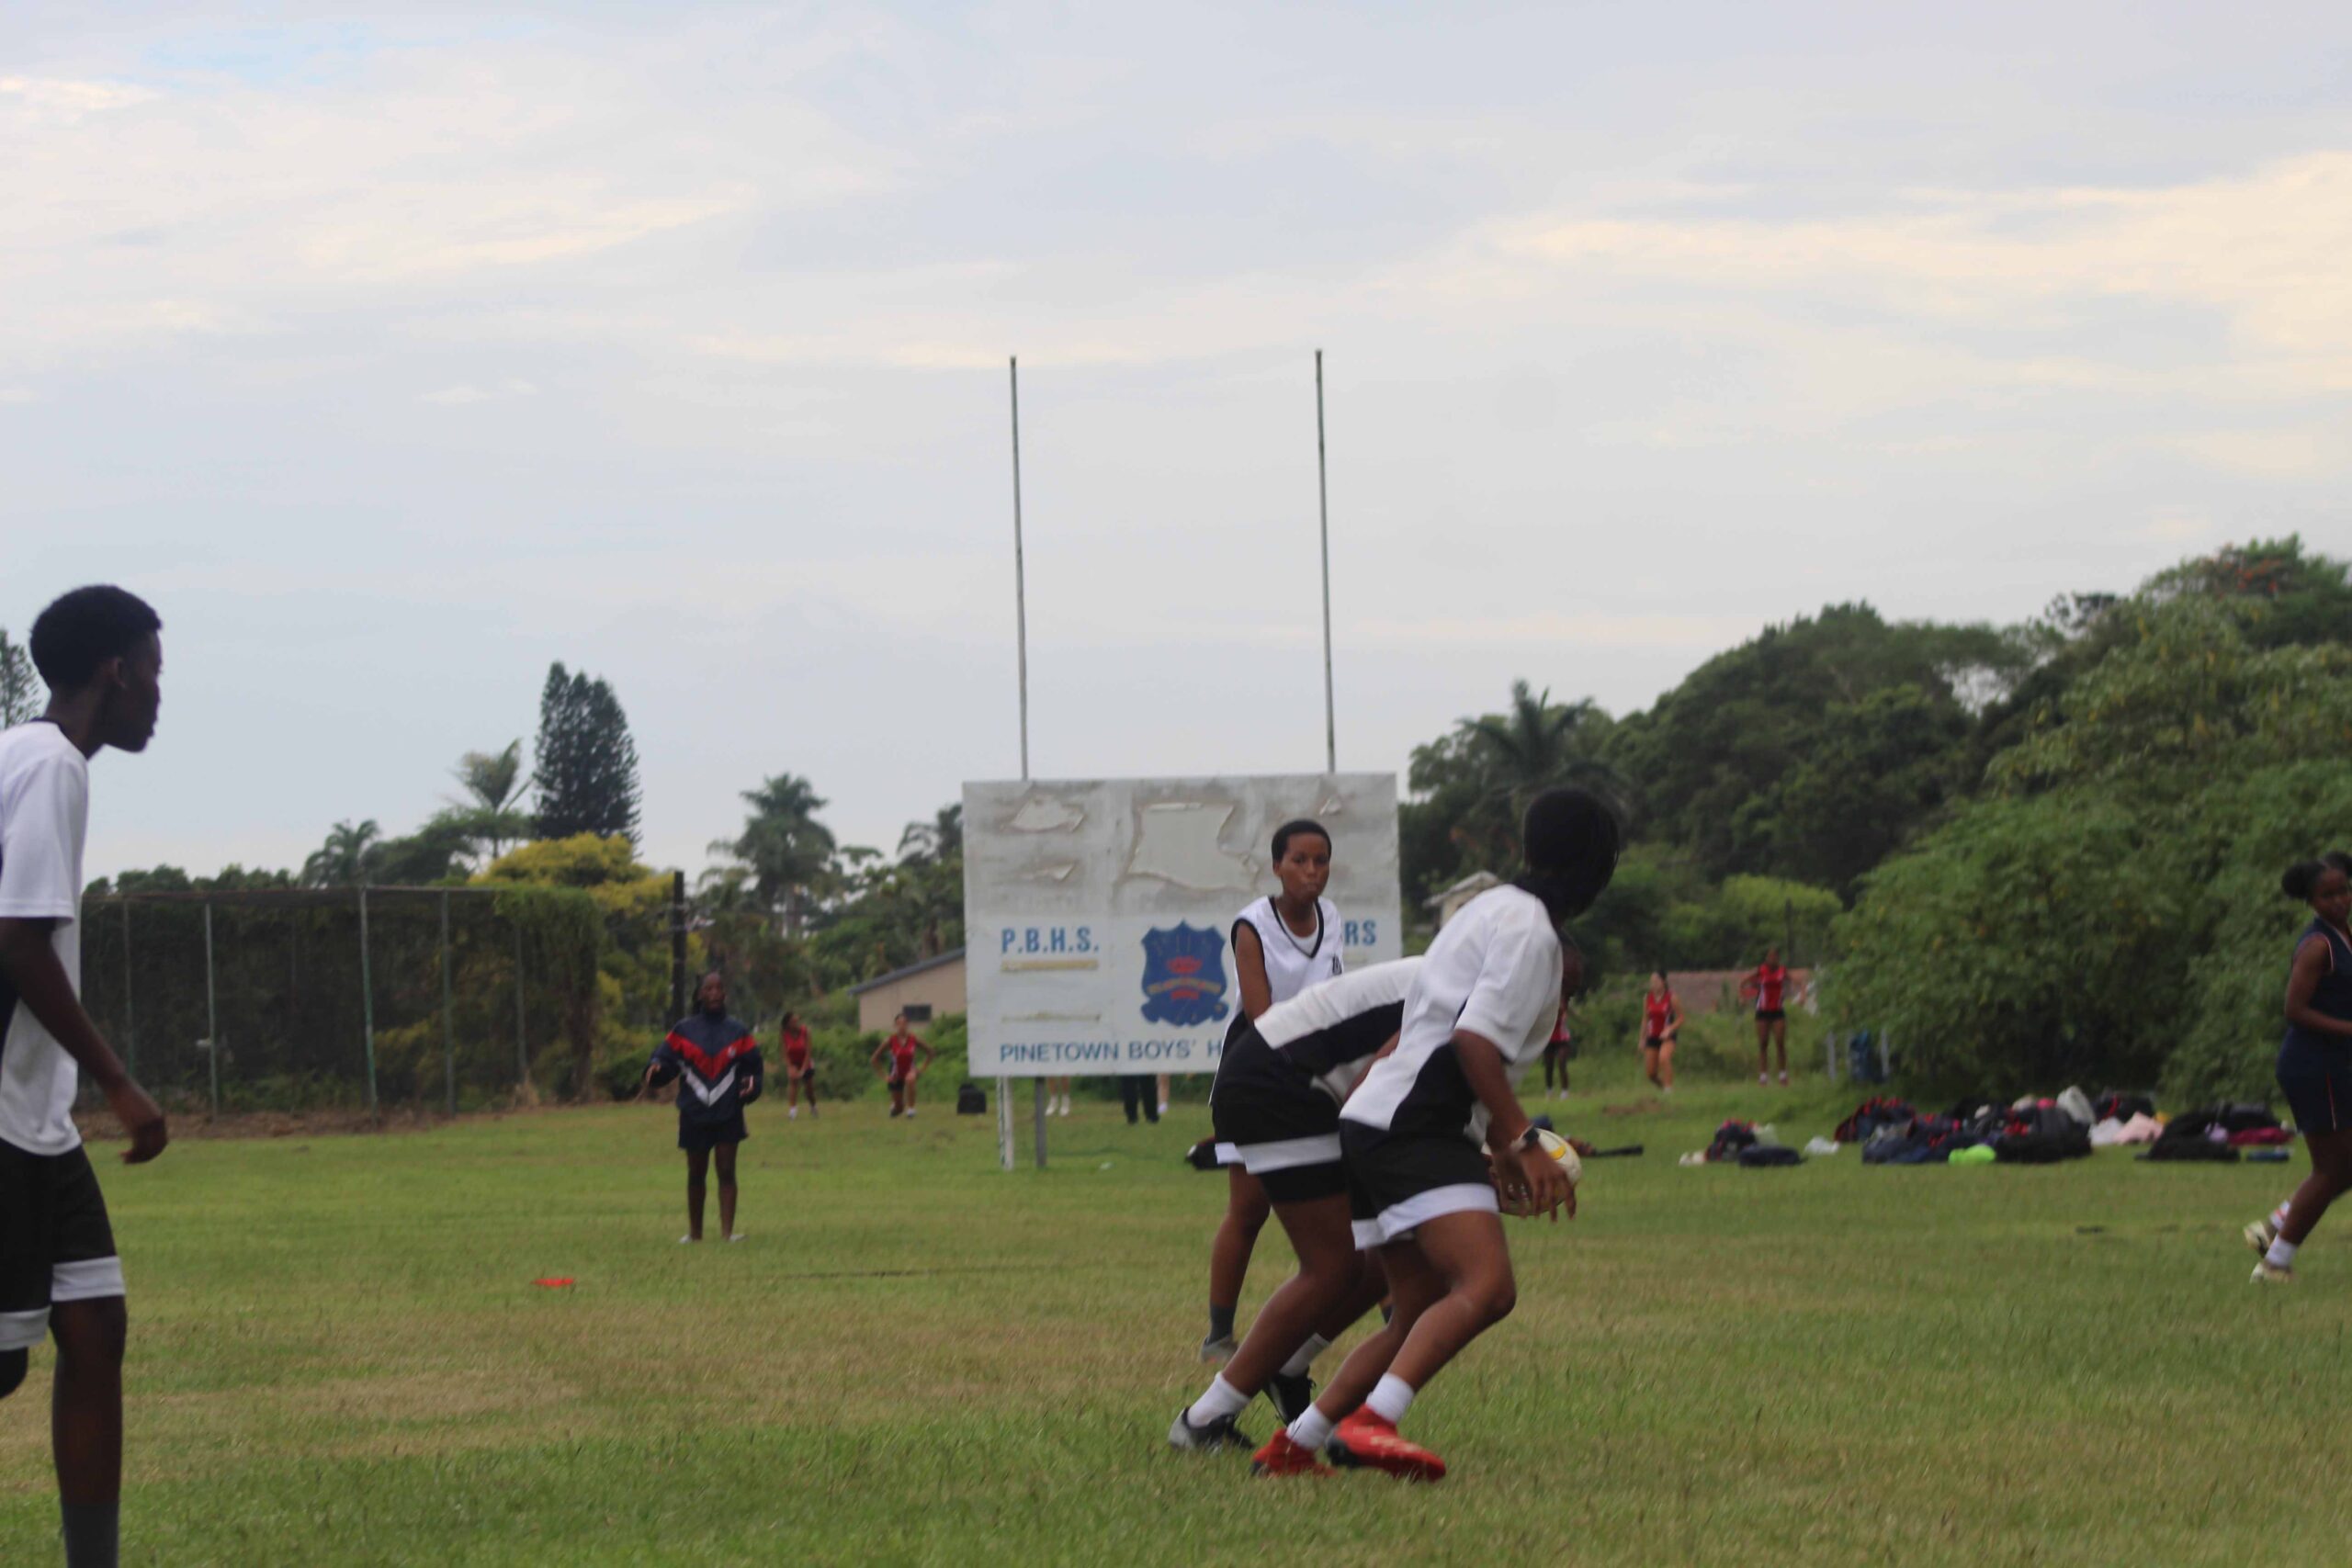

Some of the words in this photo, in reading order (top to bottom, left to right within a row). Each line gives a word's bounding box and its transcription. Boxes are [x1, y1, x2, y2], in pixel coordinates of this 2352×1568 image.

[1001, 926, 1100, 953] P.B.H.S.
[1343, 919, 1376, 946] RS
[1000, 1040, 1119, 1063] PINETOWN
